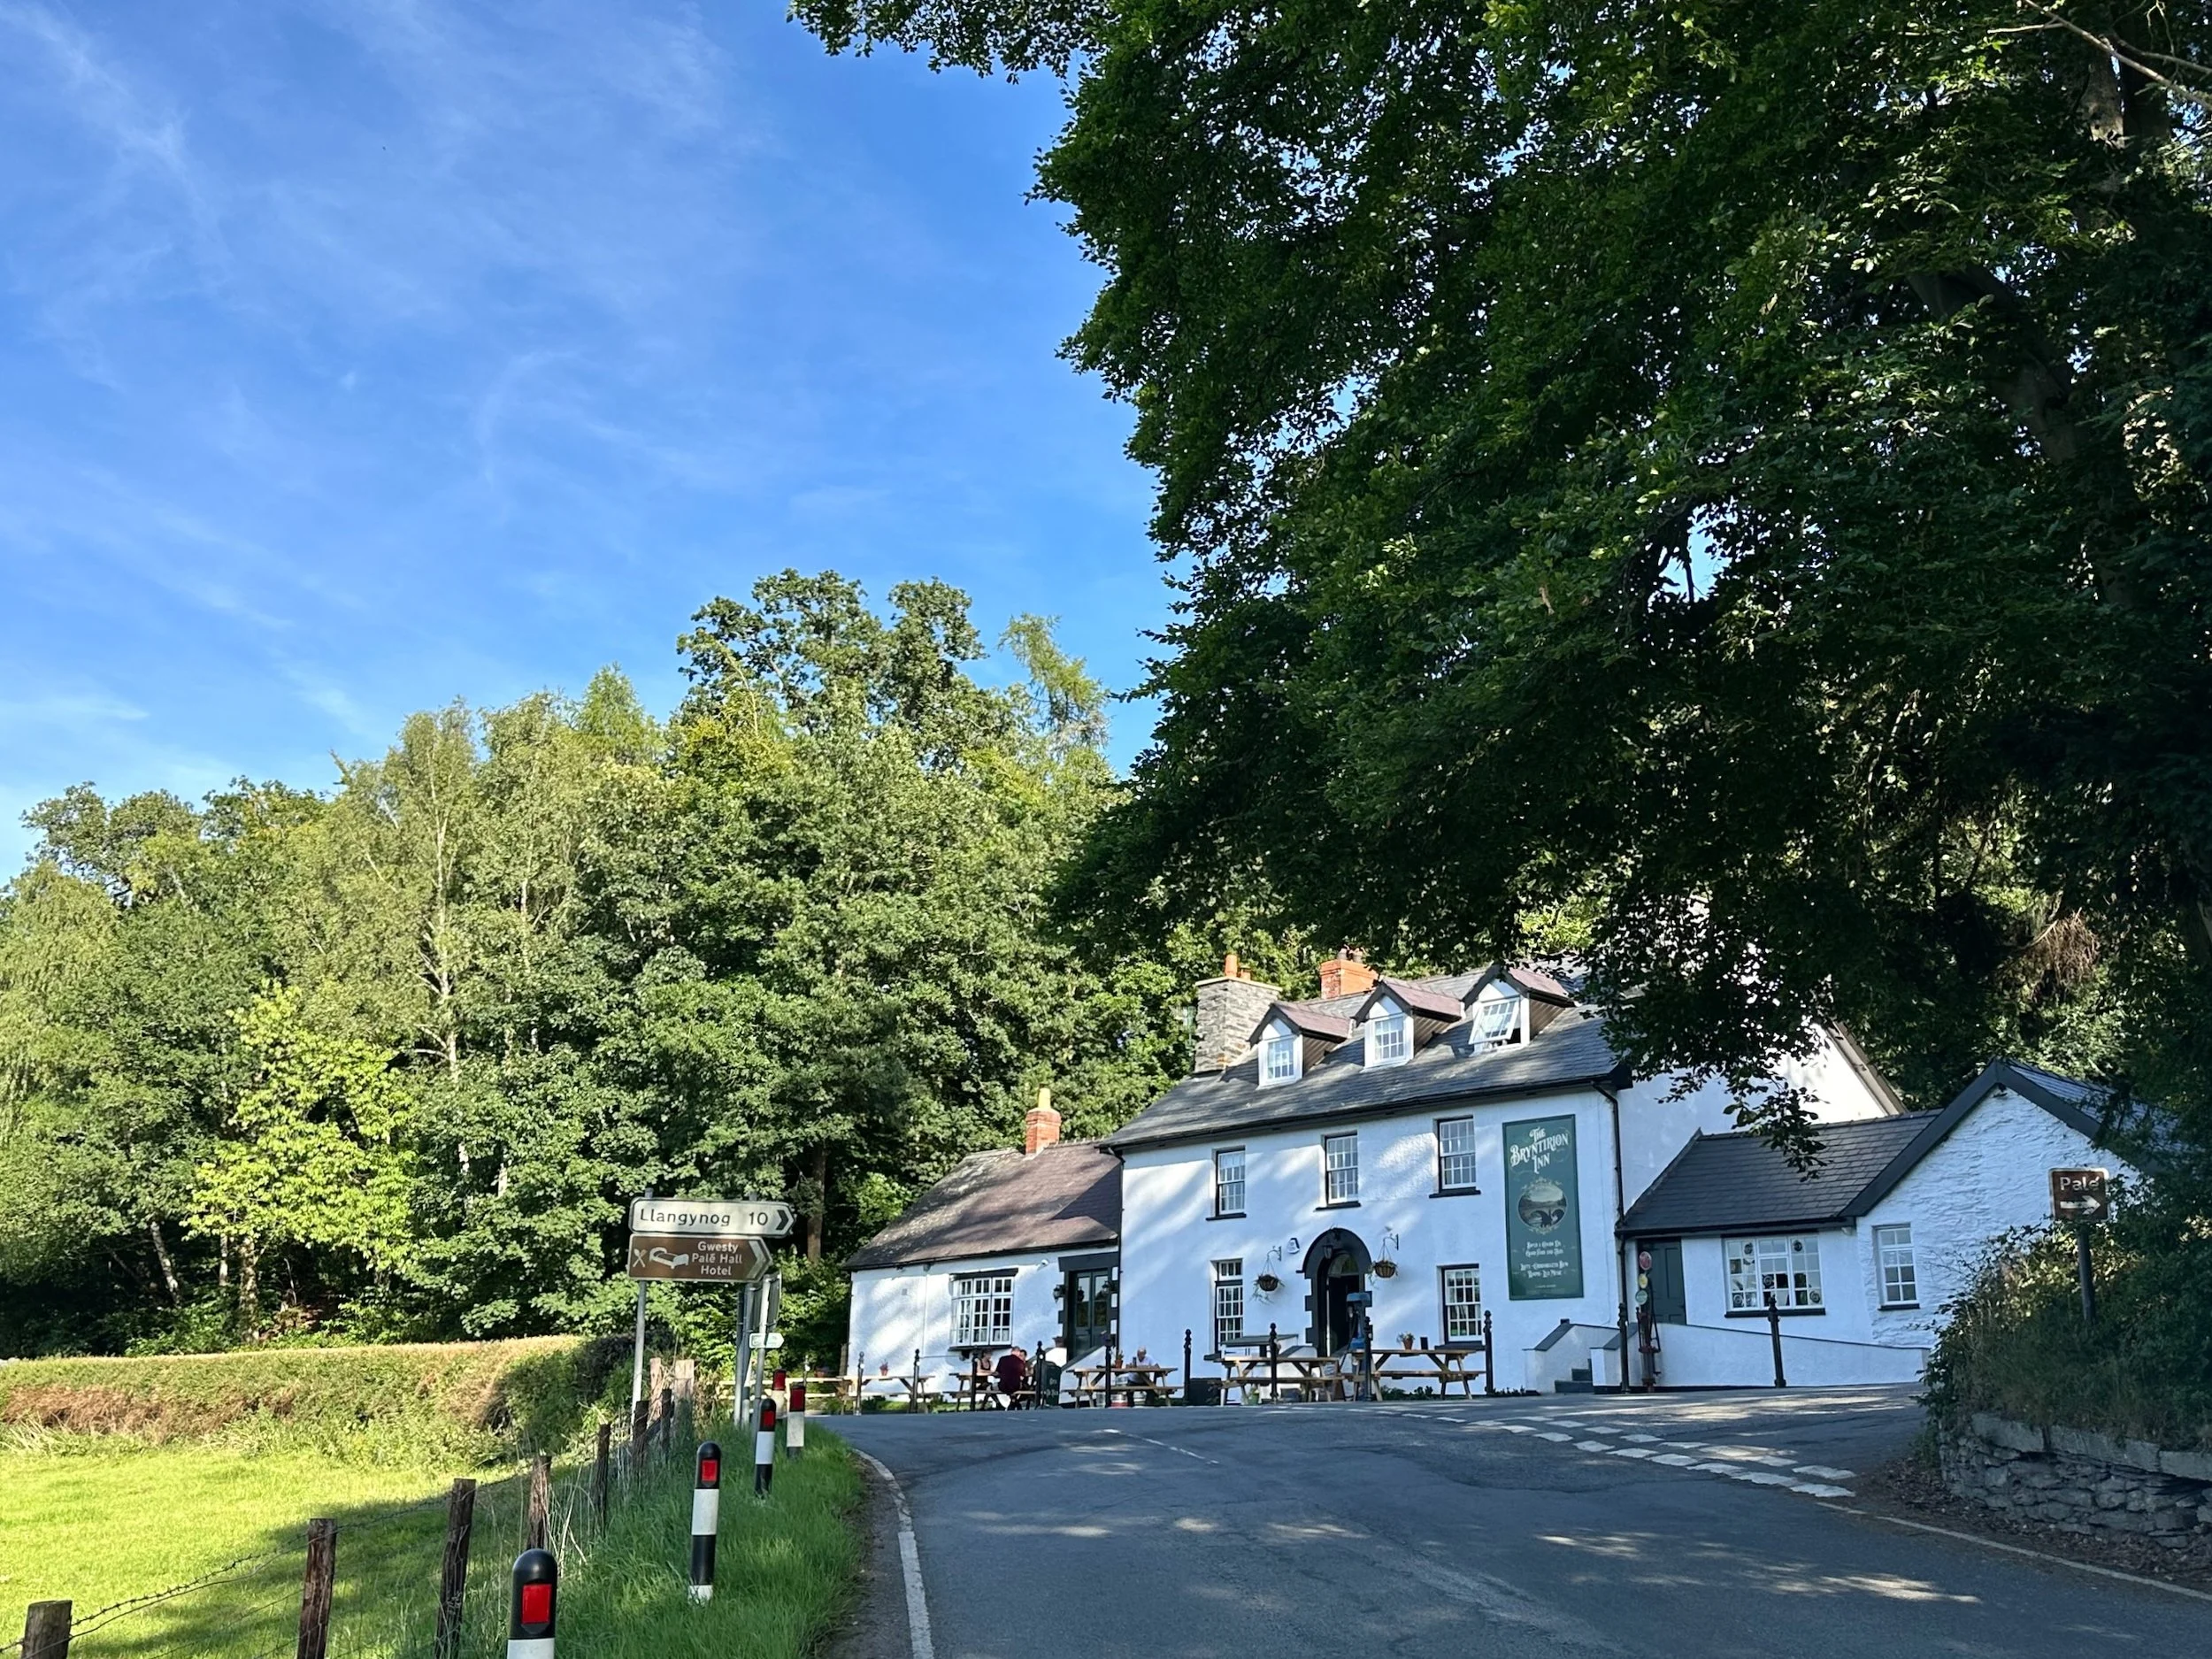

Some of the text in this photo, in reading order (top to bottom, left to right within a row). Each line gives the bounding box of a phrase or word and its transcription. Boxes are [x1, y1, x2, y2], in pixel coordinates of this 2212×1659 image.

[1529, 1126, 1546, 1142] THE
[1509, 1133, 1569, 1167] BRYNTIRION
[1532, 1154, 1550, 1174] INN
[2059, 1176, 2101, 1191] Palé
[640, 1209, 769, 1226] Llangynog 10
[697, 1240, 739, 1254] Gwesty
[691, 1253, 743, 1264] Palé Hall
[700, 1265, 732, 1276] Hotel
